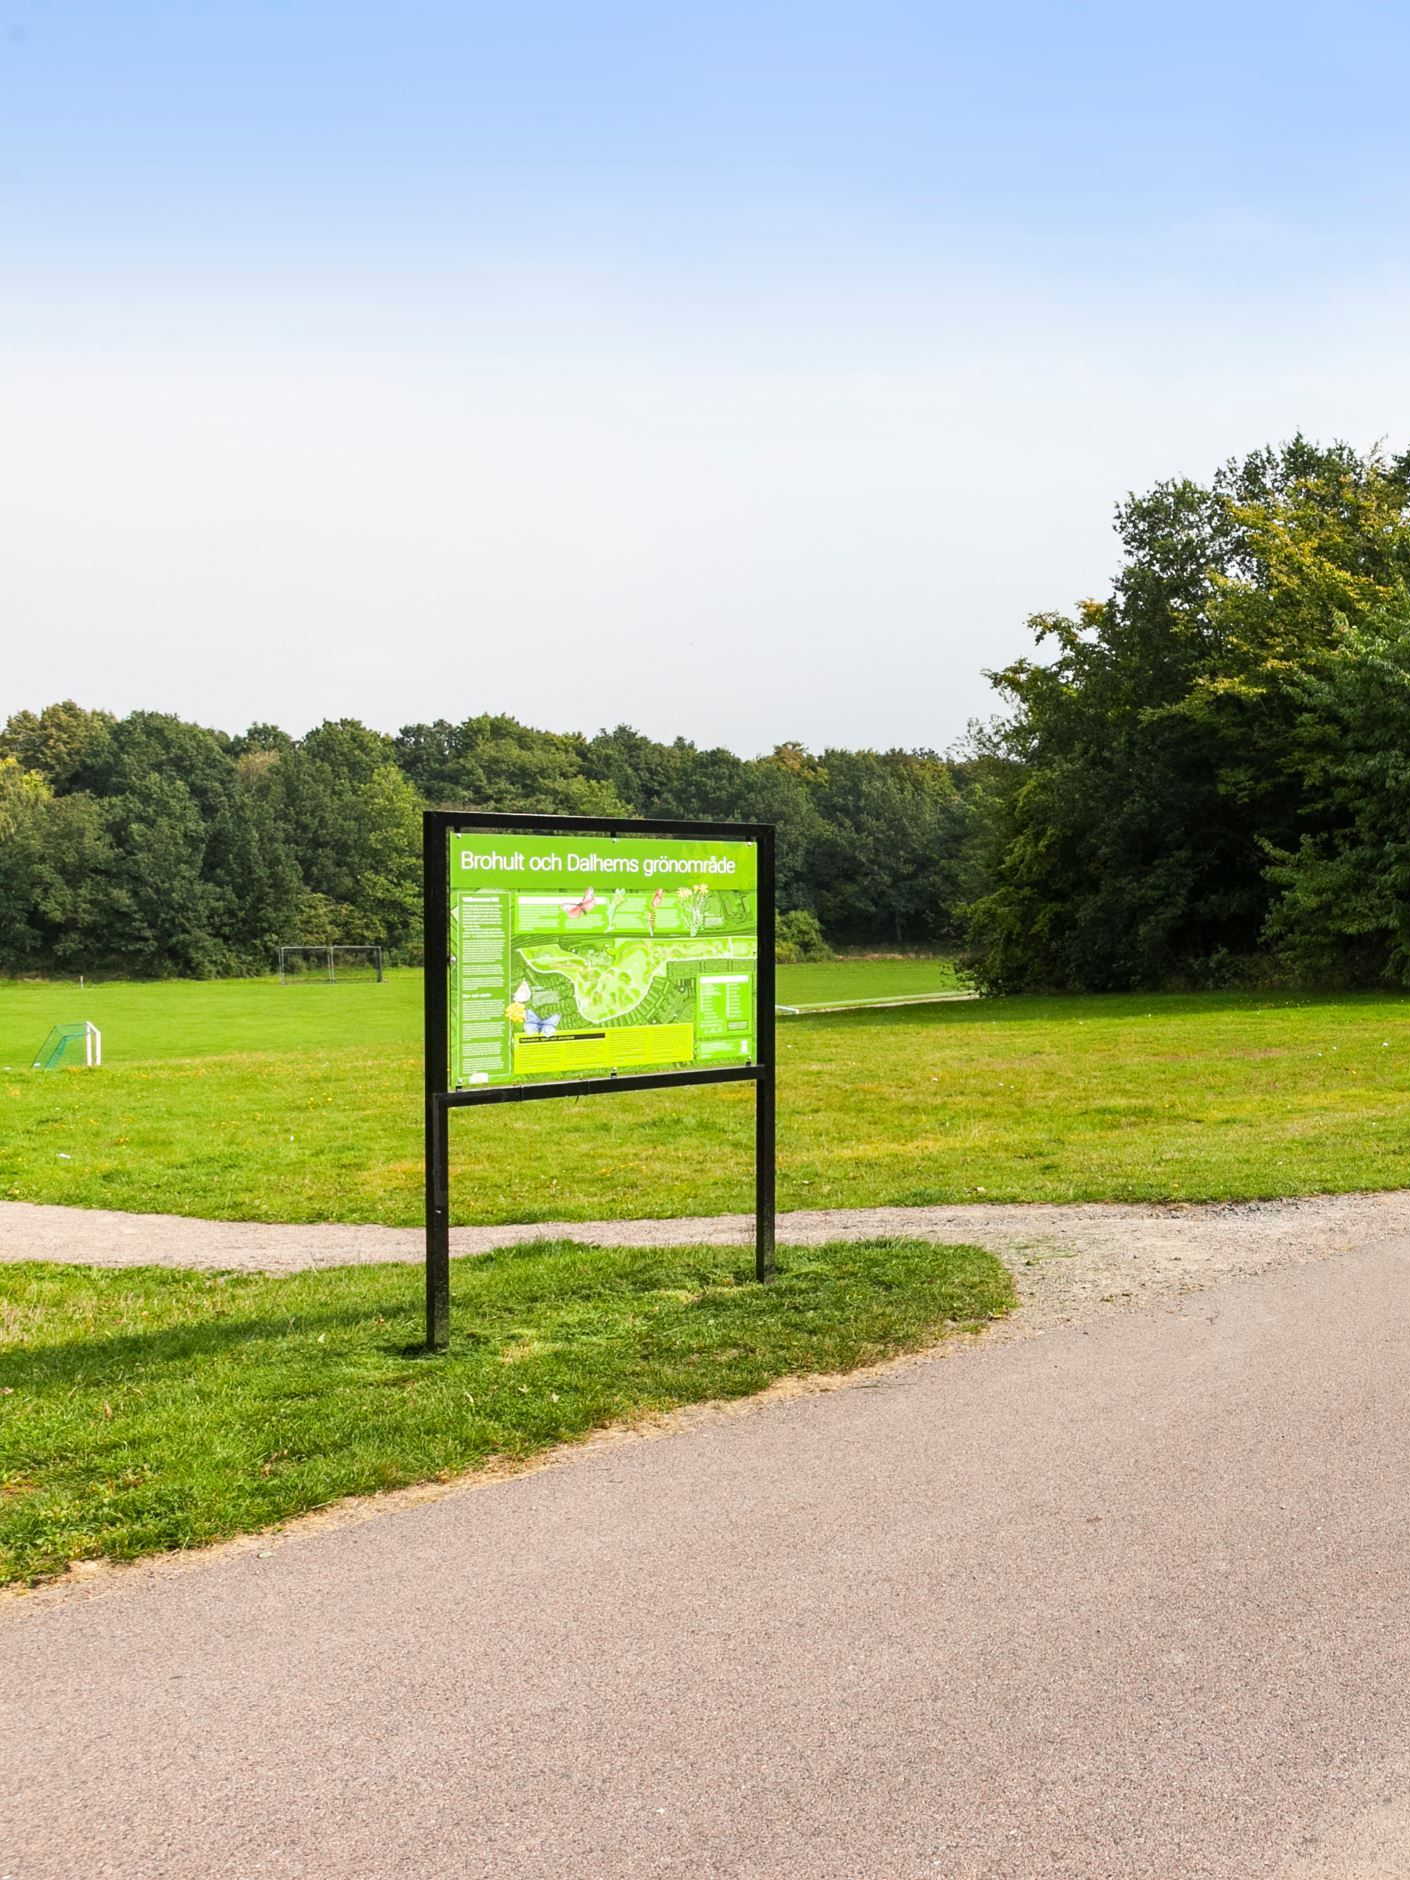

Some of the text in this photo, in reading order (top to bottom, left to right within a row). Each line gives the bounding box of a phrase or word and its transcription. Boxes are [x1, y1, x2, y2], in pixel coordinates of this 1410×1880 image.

[461, 851, 736, 876] Brohult och Dalhems grönområde
